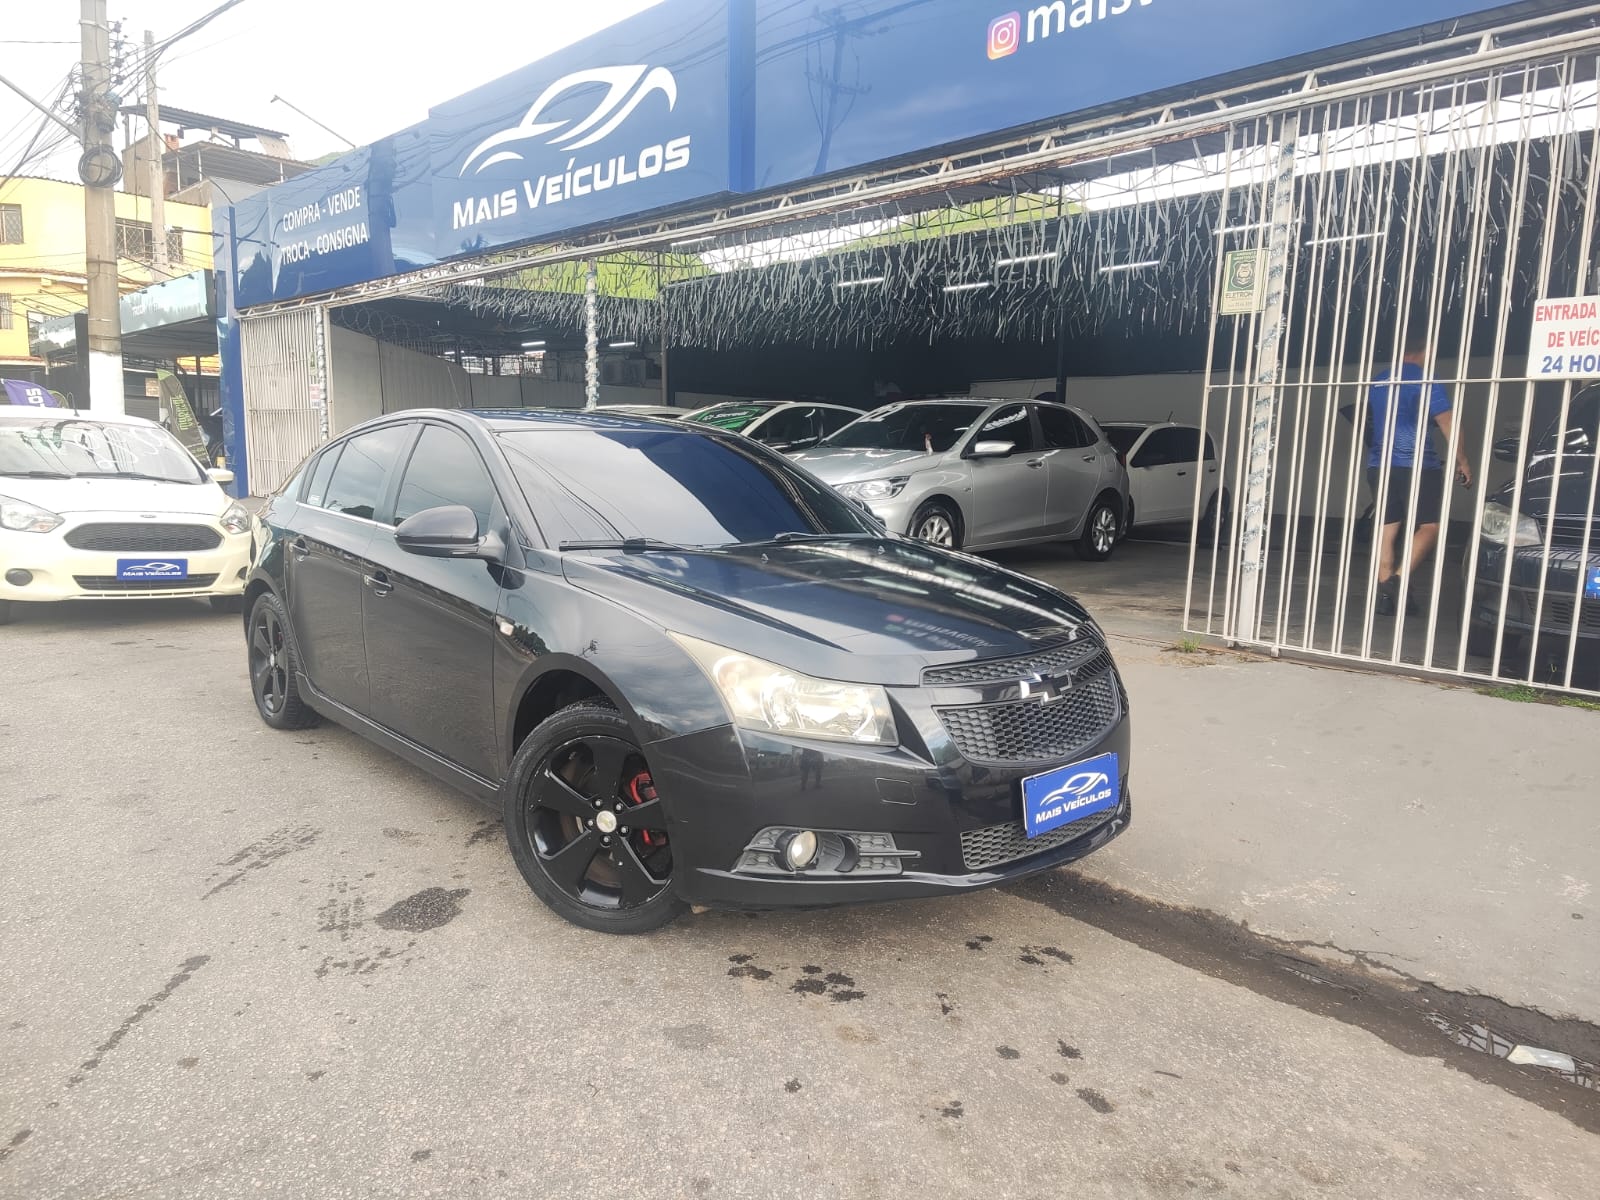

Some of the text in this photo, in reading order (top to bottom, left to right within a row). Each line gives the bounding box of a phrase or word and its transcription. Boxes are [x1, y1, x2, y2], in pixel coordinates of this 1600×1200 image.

[1027, 0, 1151, 43] mais
[453, 136, 691, 230] MAIS VEÍCULOS
[283, 202, 321, 232] COMPRA
[327, 186, 361, 217] VENDE
[281, 240, 311, 266] TROCA
[316, 222, 368, 255] CONSIGNA
[1536, 302, 1597, 322] ENTRADA
[1547, 331, 1565, 348] DE
[1541, 355, 1563, 373] 24
[1035, 788, 1112, 825] MAIS VEÍCULOS
